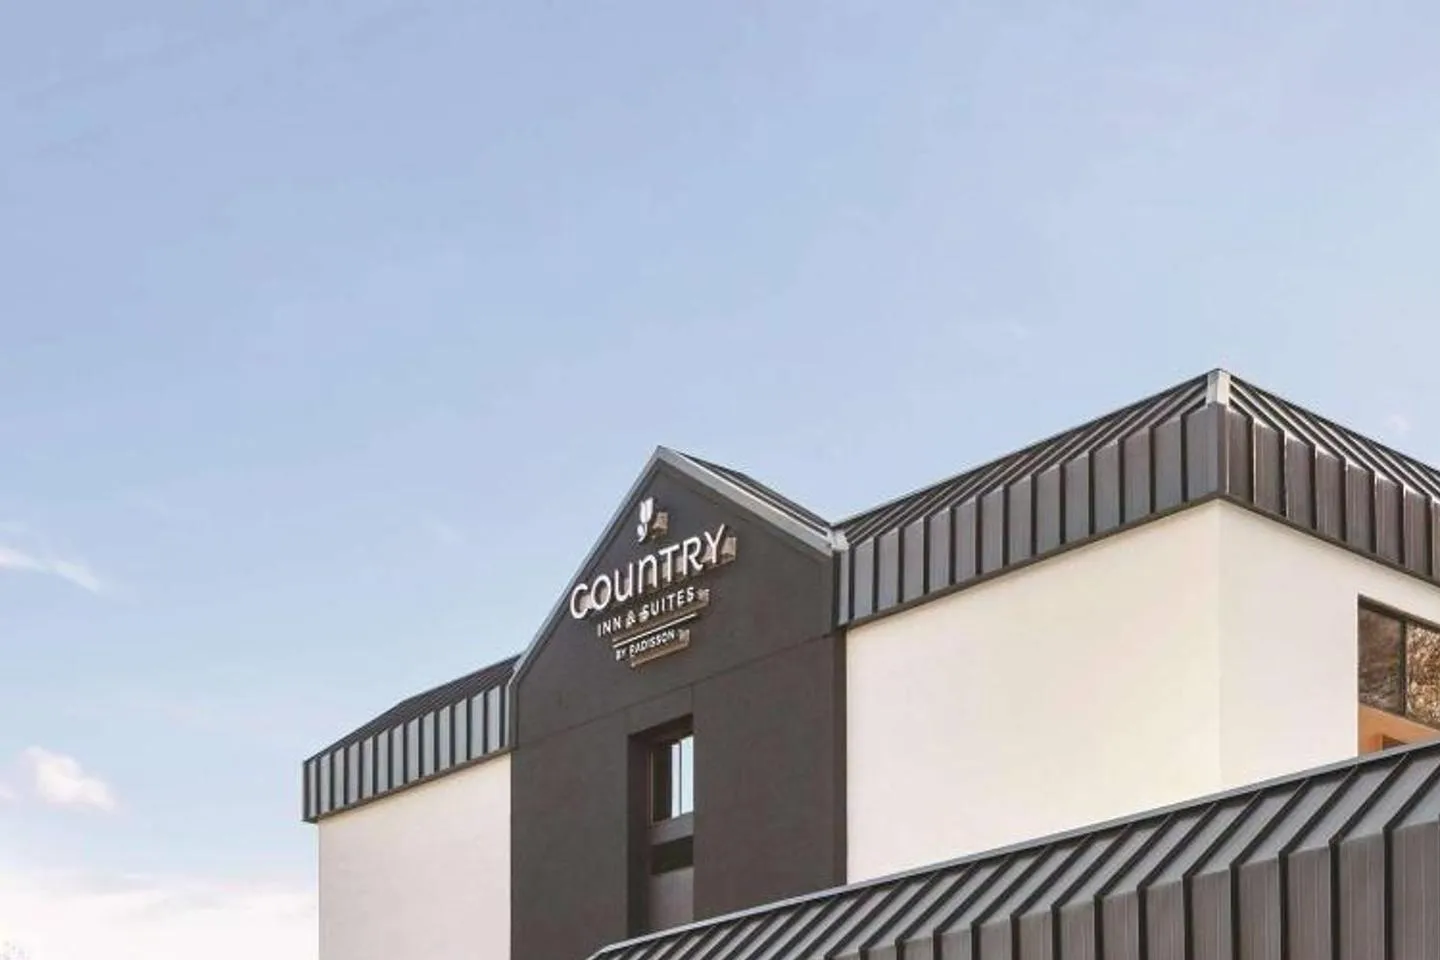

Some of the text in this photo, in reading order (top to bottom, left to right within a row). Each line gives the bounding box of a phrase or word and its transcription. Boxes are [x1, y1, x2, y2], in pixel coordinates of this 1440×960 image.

[570, 523, 725, 619] COUNTRY
[597, 586, 695, 637] INN & SUITES
